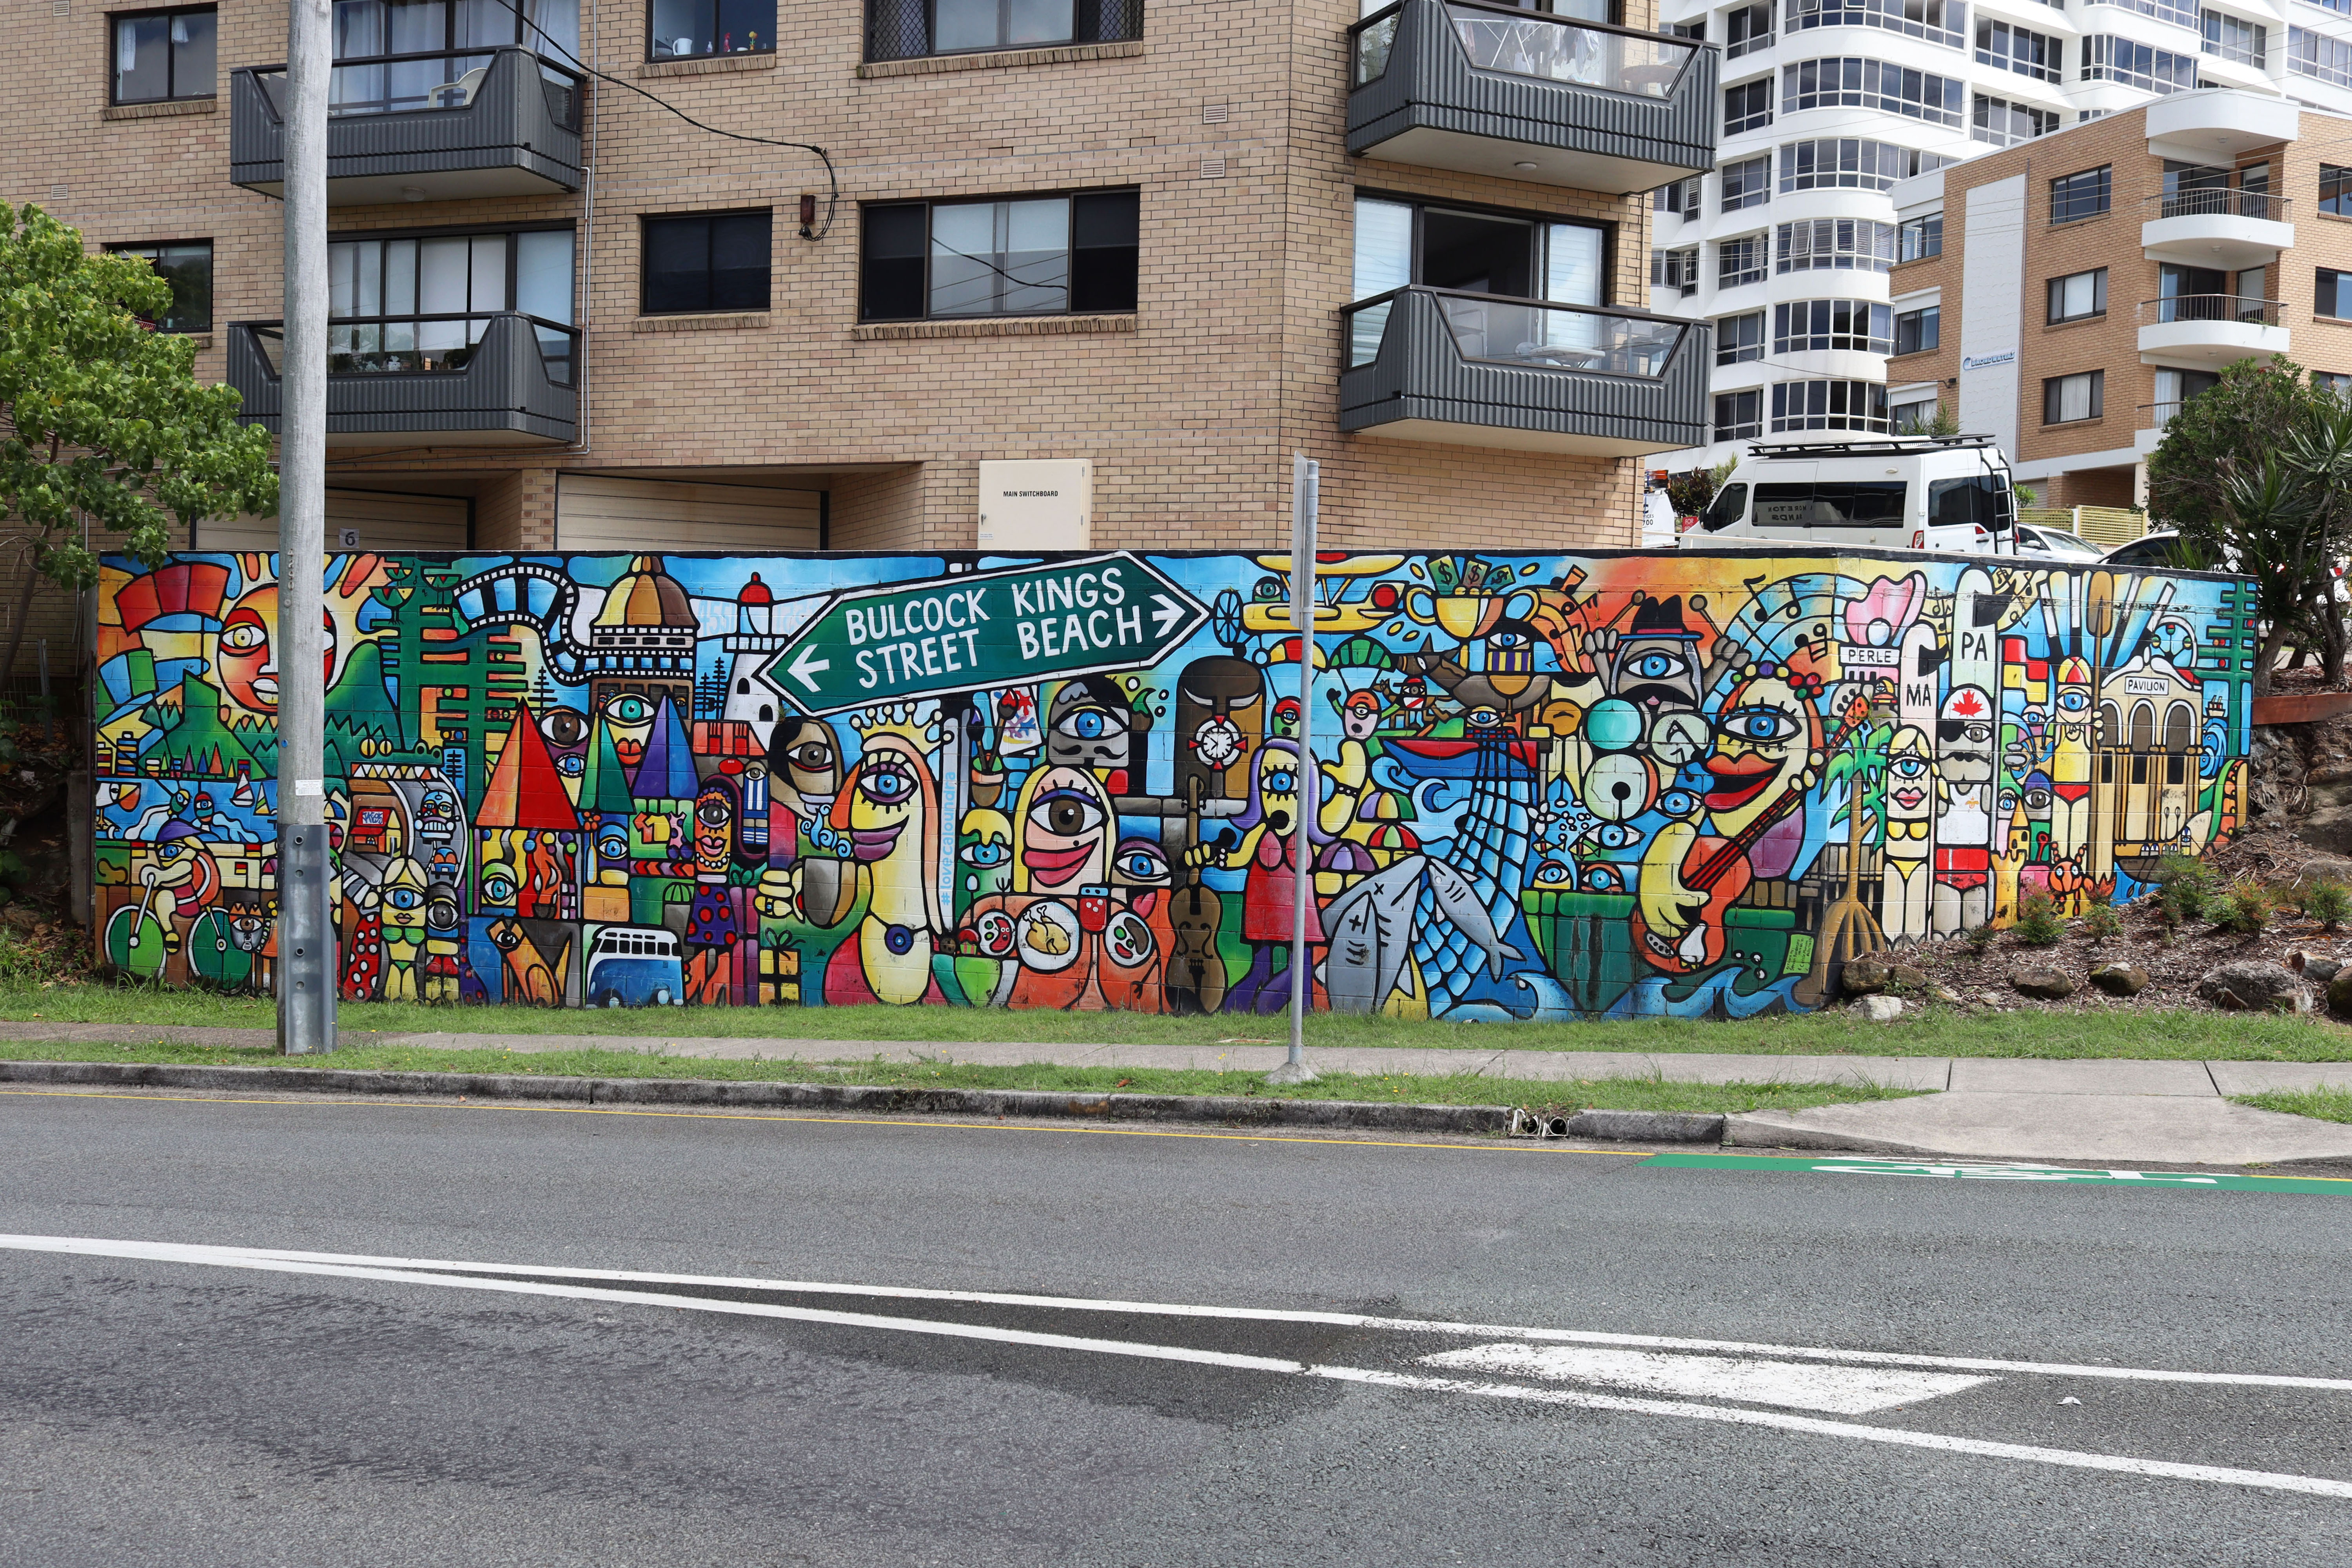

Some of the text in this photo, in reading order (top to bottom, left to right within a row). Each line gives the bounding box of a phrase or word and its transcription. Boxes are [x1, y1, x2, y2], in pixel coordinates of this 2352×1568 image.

[345, 532, 356, 546] 6
[1011, 567, 1125, 617] KINGS
[845, 587, 990, 646] BULCOCK
[1016, 605, 1143, 660] BEACH
[1962, 632, 1987, 661] PA
[855, 628, 979, 688] STREET
[1848, 649, 1892, 663] PERLE
[1906, 684, 1931, 707] MA
[2128, 679, 2165, 691] PAVILION
